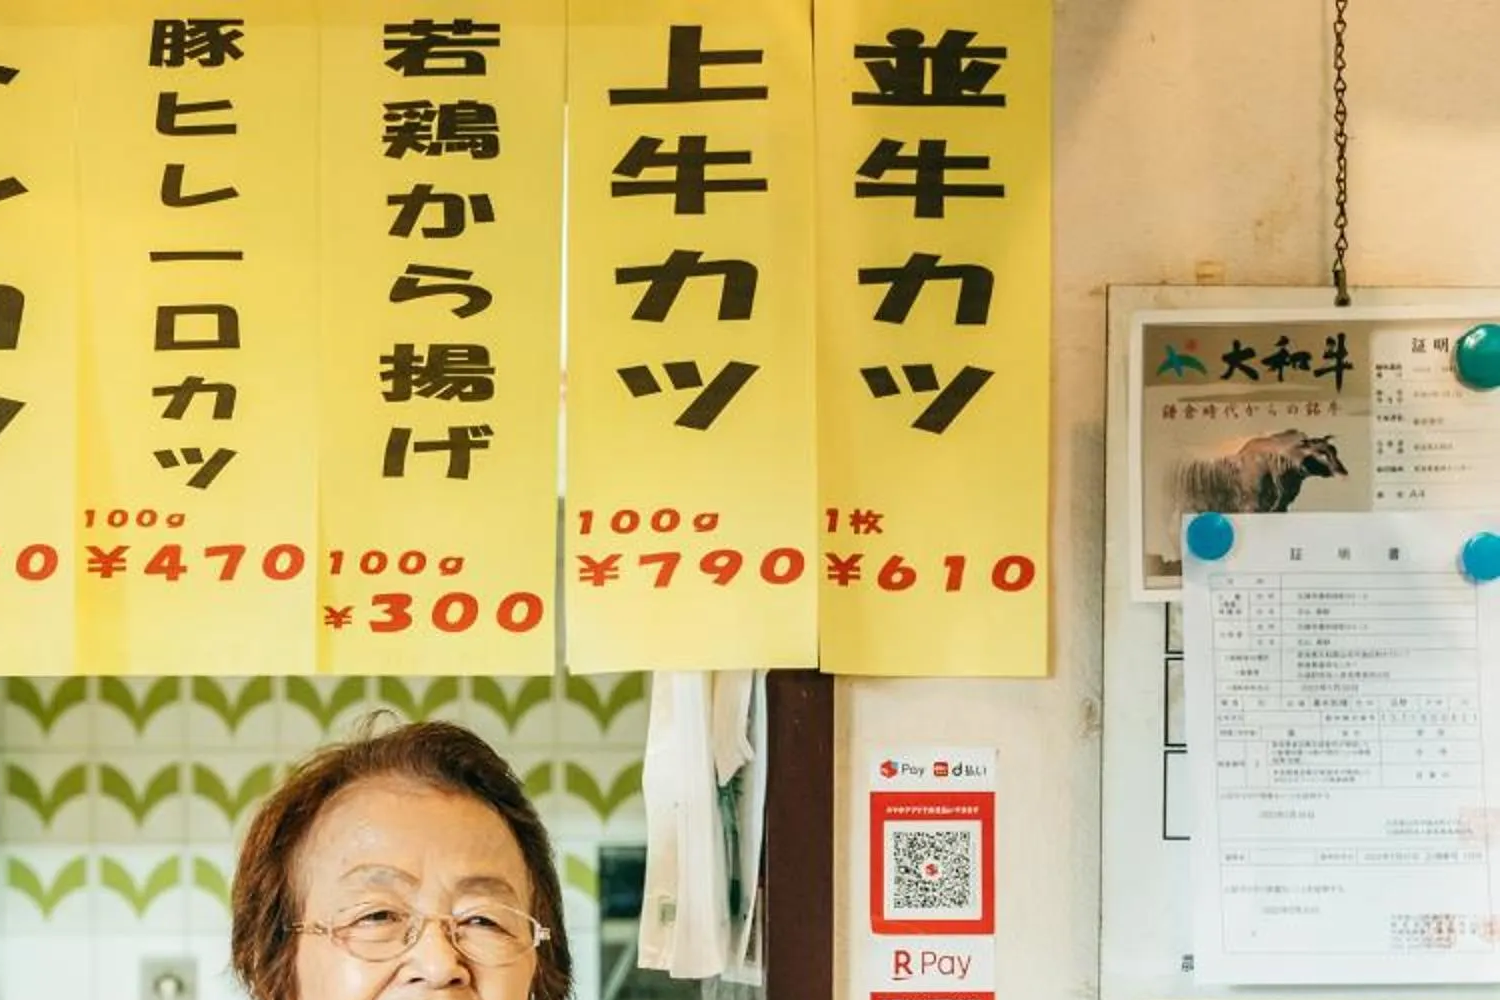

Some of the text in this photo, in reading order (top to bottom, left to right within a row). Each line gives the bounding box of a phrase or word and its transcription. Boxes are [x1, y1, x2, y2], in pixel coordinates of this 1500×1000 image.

[607, 24, 769, 432] 上牛カツ
[851, 27, 1010, 436] 並牛カツ
[379, 17, 501, 481] 若鶏から揚げ
[1219, 332, 1354, 394] 大和牛
[82, 508, 187, 531] 100g
[577, 508, 720, 536] 100g
[824, 508, 885, 535] 1枚
[85, 542, 306, 583] ¥470
[328, 550, 465, 577] 100g
[577, 546, 807, 589] ¥790
[826, 553, 1036, 593] ¥610
[324, 592, 545, 634] ¥300
[901, 763, 925, 776] Pay
[920, 951, 972, 979] Pay
